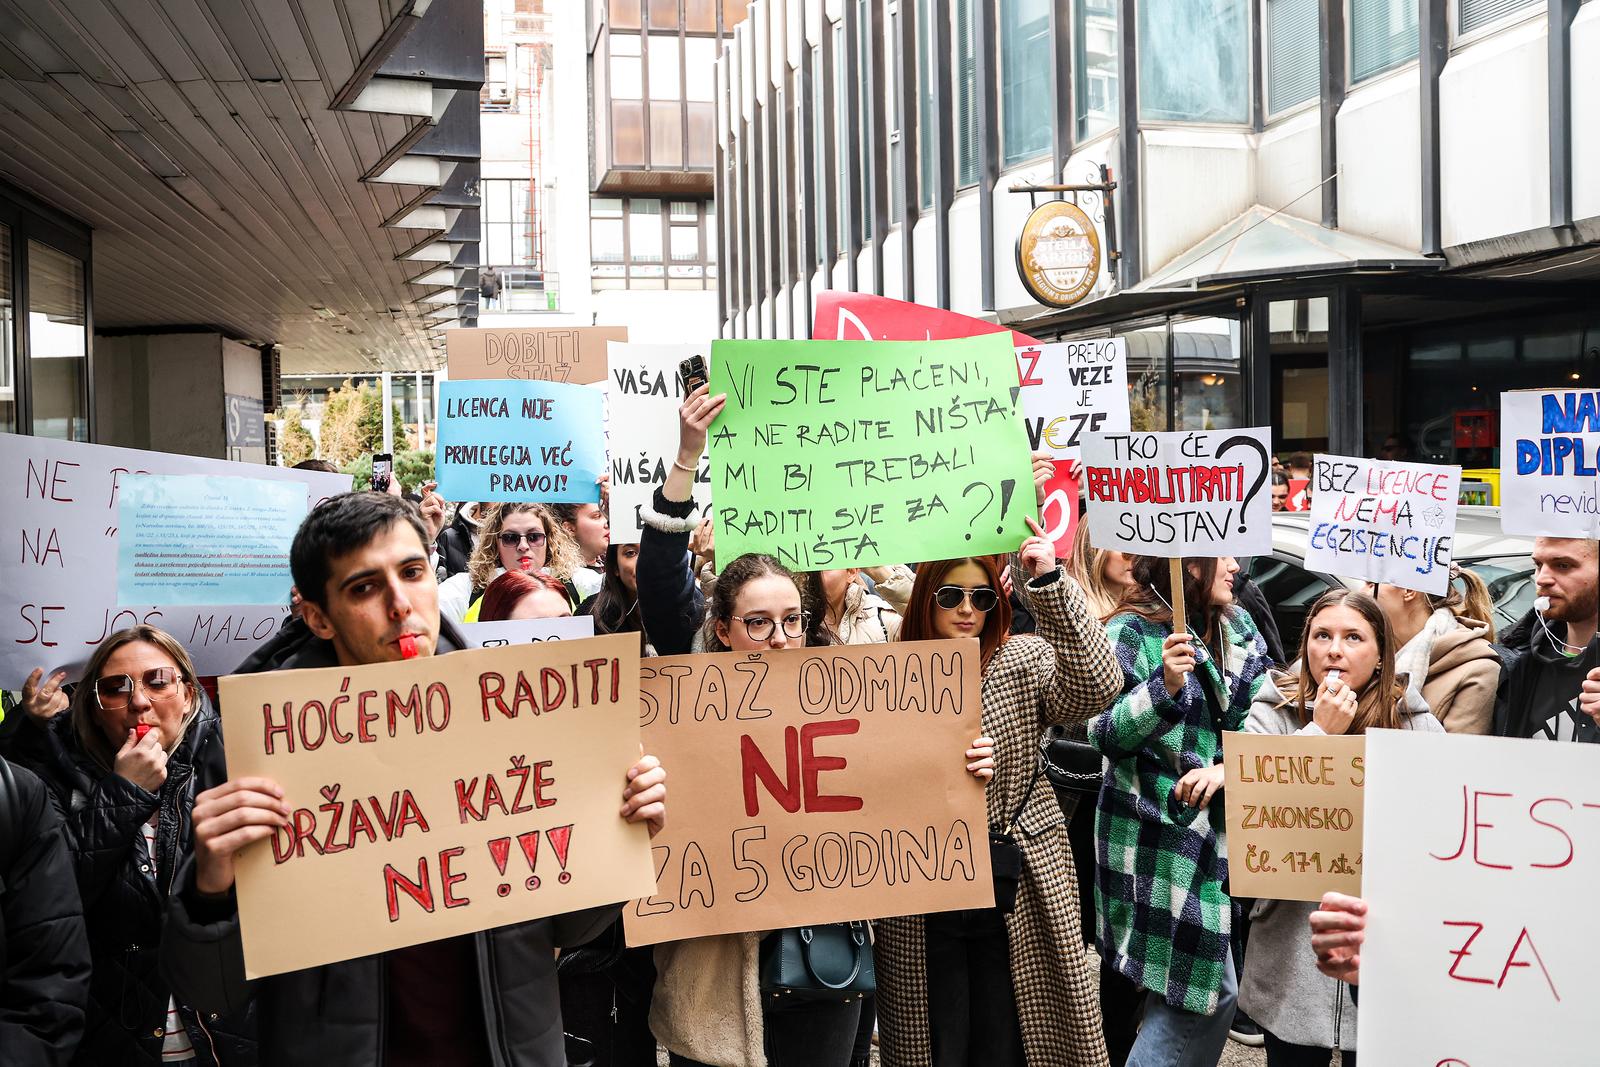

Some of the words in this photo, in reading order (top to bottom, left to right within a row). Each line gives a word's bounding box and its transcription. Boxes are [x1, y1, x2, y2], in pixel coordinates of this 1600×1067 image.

[485, 331, 580, 366] DOBITI
[1067, 341, 1117, 365] PREKO
[613, 364, 668, 398] VAŠA
[725, 360, 755, 410] VI
[770, 365, 841, 406] STE
[860, 356, 989, 398] PLAĆENI,
[1068, 365, 1113, 387] VEZE
[447, 397, 510, 419] LICENCA
[521, 397, 555, 420] NIJE
[713, 423, 737, 449] A
[754, 423, 788, 447] NE
[797, 419, 894, 448] RADITE
[915, 386, 1021, 437] NIŠTA!
[1076, 389, 1093, 407] JE
[1541, 391, 1600, 434] NA
[540, 440, 574, 467] VEĆ
[1104, 435, 1158, 461] TKO
[1180, 432, 1210, 458] ĆE
[1516, 437, 1600, 477] DIPL
[26, 457, 81, 502] NE
[612, 451, 668, 486] NAŠA
[725, 462, 757, 493] MI
[783, 462, 812, 492] BI
[835, 445, 976, 488] TREBALI
[1086, 463, 1244, 504] REHABILITIRATI
[1315, 460, 1359, 494] BEZ
[1366, 467, 1449, 501] LICENCE
[719, 508, 813, 536] RADITI
[832, 503, 884, 531] SVE
[906, 493, 949, 523] ZA
[962, 479, 1016, 542] ?!
[1334, 495, 1413, 529] NEMA
[21, 527, 64, 568] NA
[777, 532, 880, 568] NIŠTA
[15, 604, 66, 647] SE
[262, 676, 452, 755] HOĆEMO
[478, 657, 621, 722] RADITI
[639, 654, 773, 728] STAŽ
[798, 651, 964, 715] ODMAH
[739, 718, 864, 818] NE
[1239, 754, 1335, 786] LICENCE
[270, 783, 431, 865] DRŽAVA
[454, 754, 558, 825] KAŽE
[1241, 804, 1354, 832] ZAKONSKO
[1428, 785, 1600, 870] JES
[635, 841, 715, 918] ZA
[731, 825, 769, 903] 5
[780, 818, 976, 893] GODINA
[1281, 852, 1323, 873] 171
[382, 846, 471, 923] NE
[1442, 920, 1561, 1003] ZA
